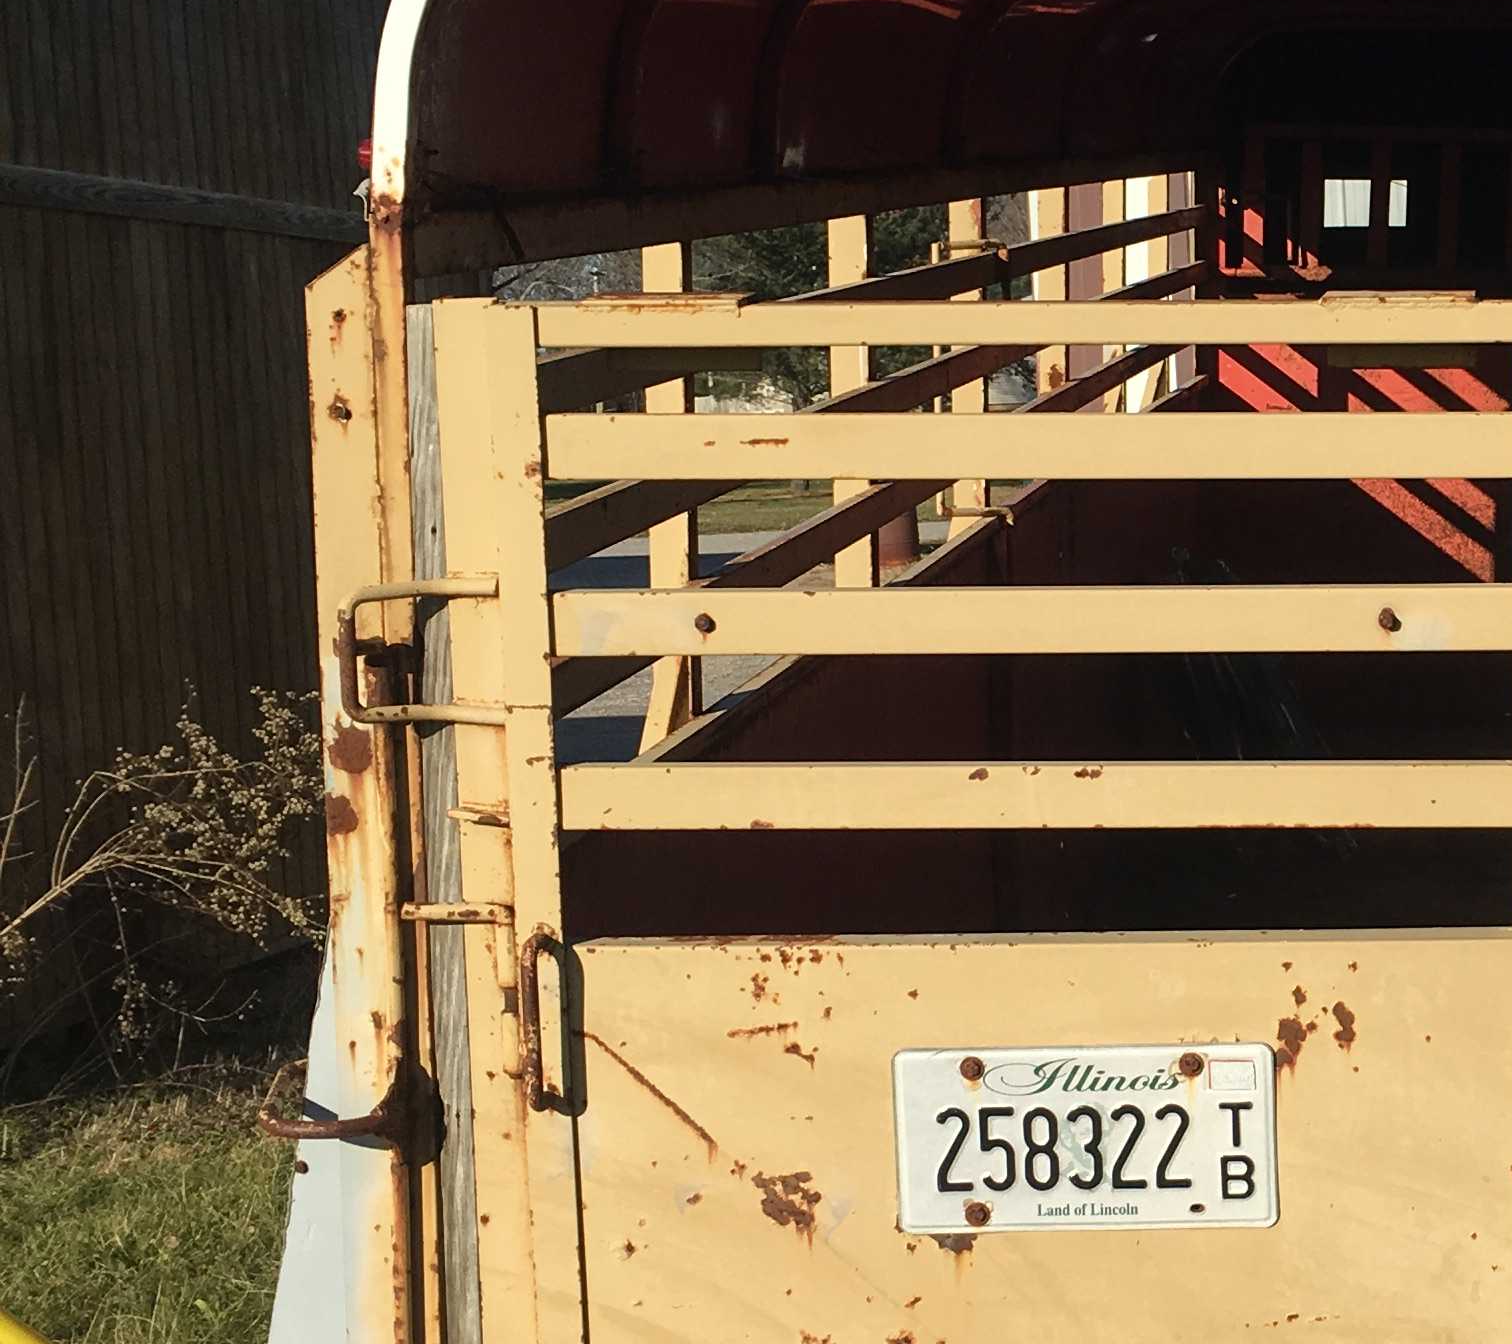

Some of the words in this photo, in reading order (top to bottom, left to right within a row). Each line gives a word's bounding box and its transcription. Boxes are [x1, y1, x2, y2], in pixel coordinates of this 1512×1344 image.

[982, 1057, 1181, 1096] Illinois
[1218, 1101, 1253, 1148] T
[936, 1104, 1192, 1193] 258322
[1219, 1155, 1255, 1199] B
[1037, 1203, 1071, 1217] Land
[1075, 1203, 1087, 1216] of
[1090, 1202, 1139, 1216] Lincoln
